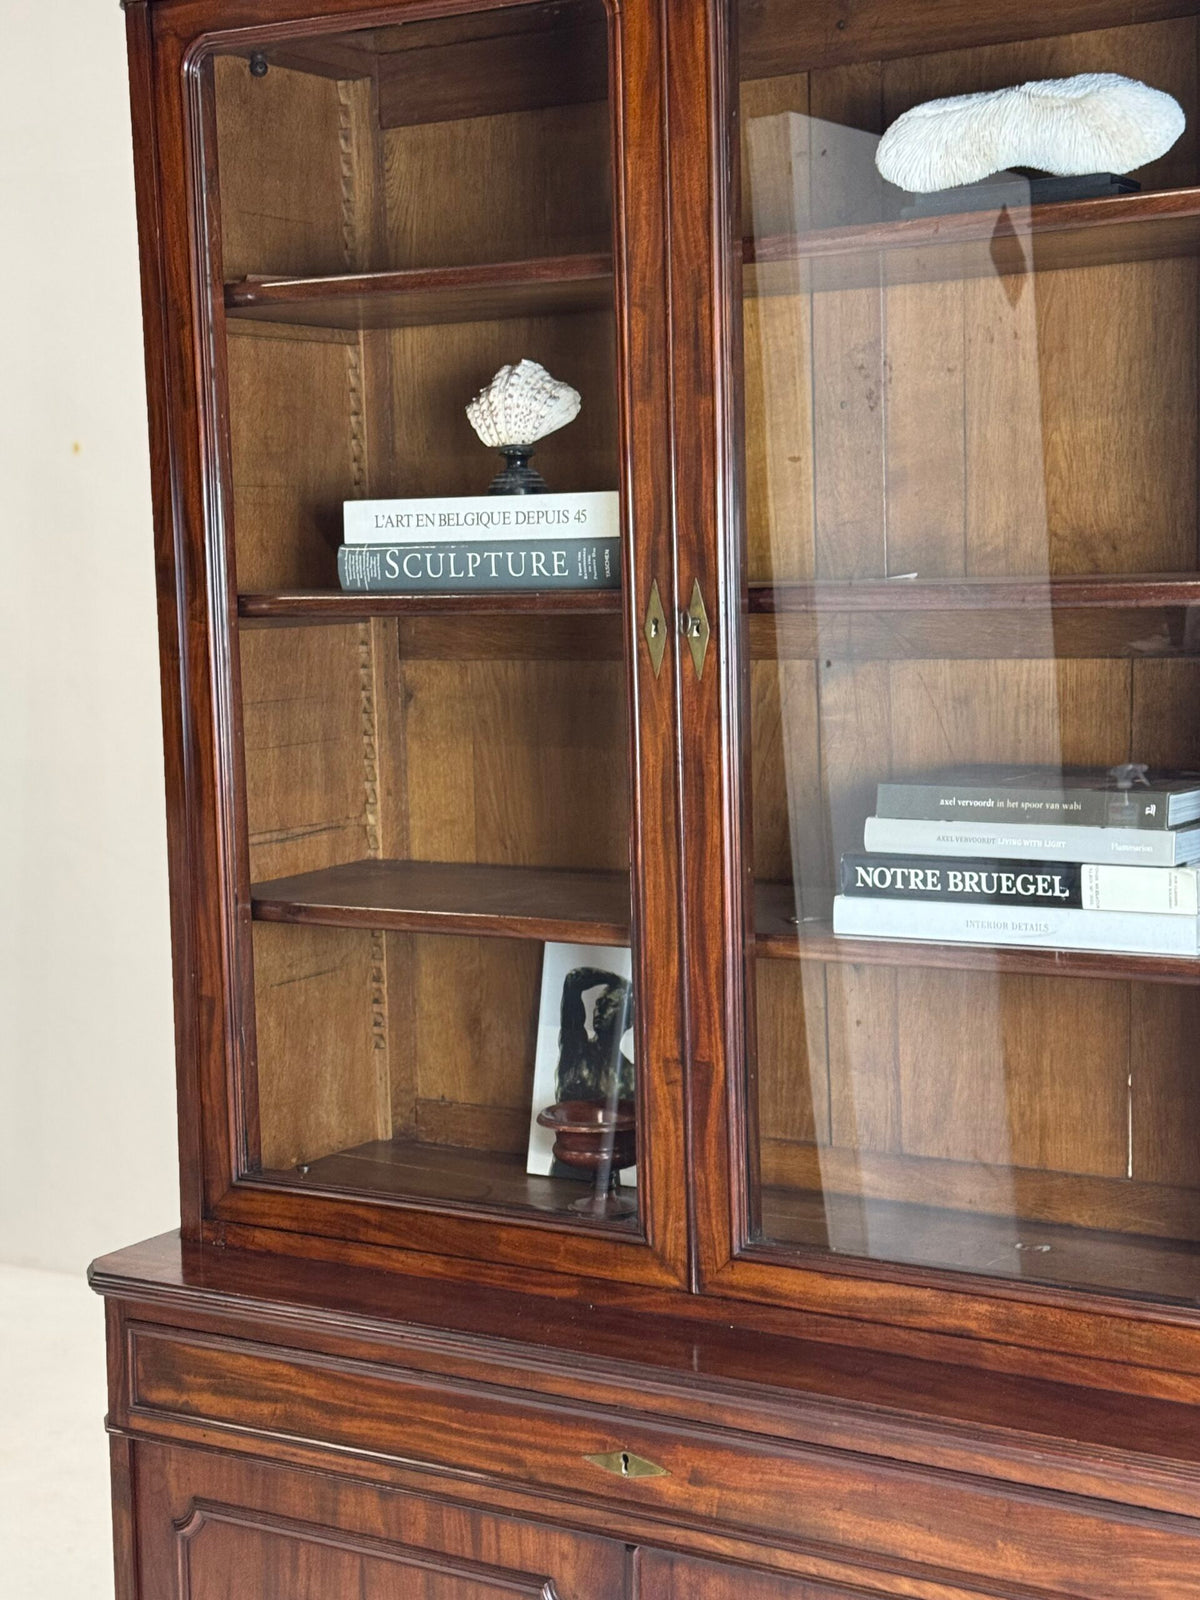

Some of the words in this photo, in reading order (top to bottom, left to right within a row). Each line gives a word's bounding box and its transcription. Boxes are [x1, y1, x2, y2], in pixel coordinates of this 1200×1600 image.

[375, 513, 414, 529] L'ART
[416, 512, 435, 528] EN
[438, 511, 512, 529] BELGIQUE
[515, 509, 570, 525] DEPUIS
[573, 508, 588, 524] 45
[384, 549, 570, 579] SCULPTURE
[939, 797, 956, 807] axel
[957, 798, 995, 808] vervoordt
[996, 799, 1005, 808] in
[1006, 799, 1019, 809] het
[1021, 801, 1043, 811] spoor
[1062, 801, 1082, 811] wabi
[936, 835, 954, 843] AXEL
[955, 836, 996, 845] VERVOORDT
[1023, 839, 1042, 847] WITH
[1044, 840, 1067, 849] LIGHT
[855, 866, 942, 892] NOTRE
[947, 871, 1070, 898] BRUEGEL
[965, 919, 1008, 931] INTERIOR
[1011, 921, 1050, 933] DETAILS
